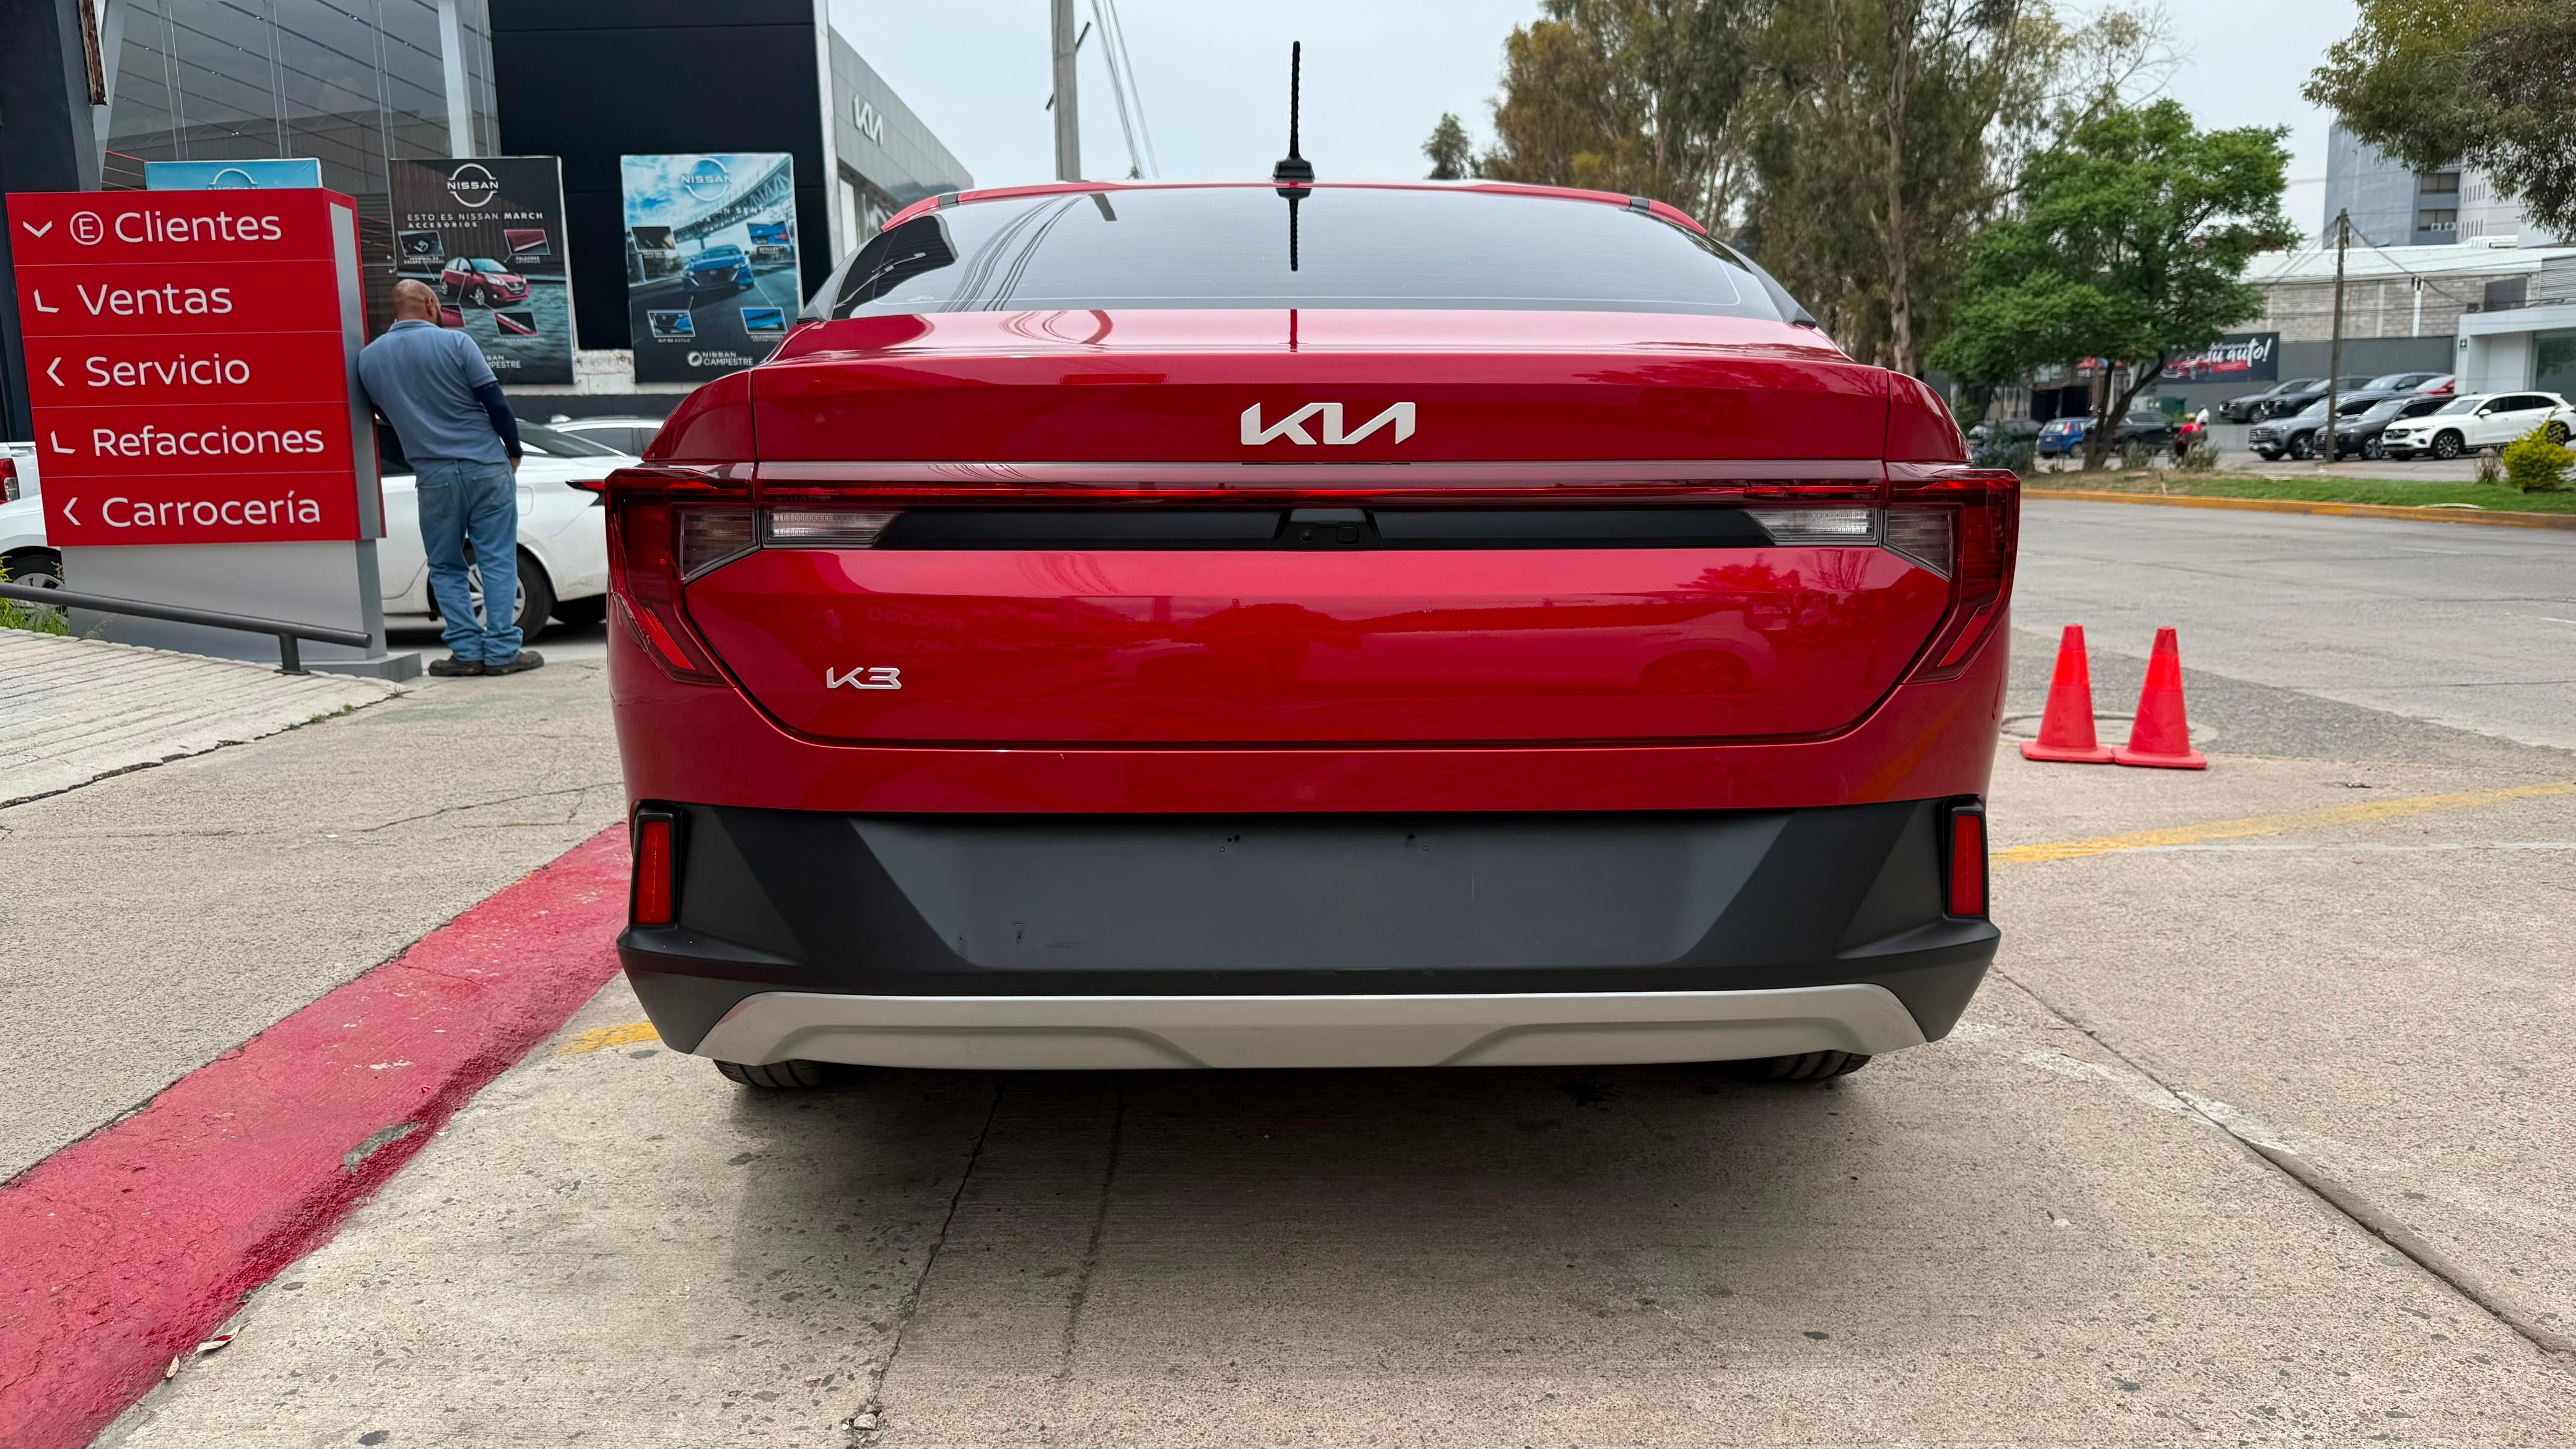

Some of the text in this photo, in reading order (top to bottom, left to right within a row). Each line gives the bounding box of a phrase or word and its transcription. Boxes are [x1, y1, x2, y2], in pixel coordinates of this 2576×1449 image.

[853, 94, 884, 146] KIA
[446, 181, 498, 190] NISSAN
[681, 175, 733, 184] NISSAN
[115, 210, 282, 243] Clientes
[407, 212, 543, 221] ESTO ES NISSAN MARCH
[77, 282, 233, 315] Ventas
[488, 360, 521, 368] PESTRE
[703, 357, 754, 366] CAMPESTRE
[2226, 337, 2273, 367] auto!
[85, 354, 250, 387] Servicio
[1241, 402, 1416, 445] KIA
[93, 425, 325, 457] Refacciones
[102, 490, 321, 528] Carrocería
[826, 667, 902, 690] K3
